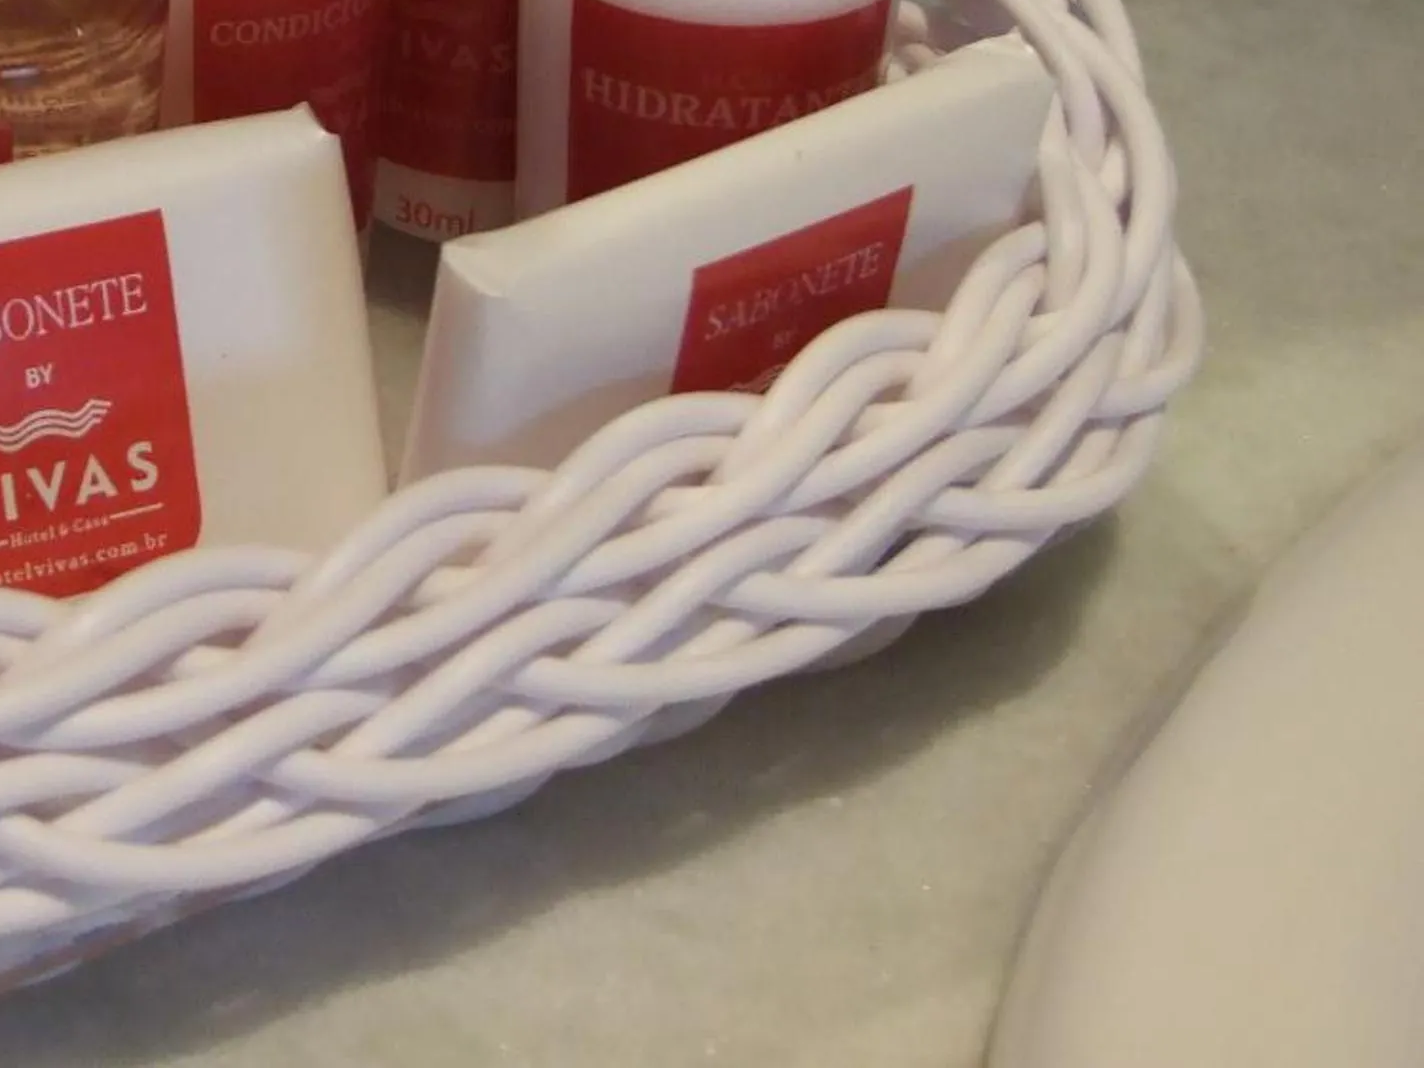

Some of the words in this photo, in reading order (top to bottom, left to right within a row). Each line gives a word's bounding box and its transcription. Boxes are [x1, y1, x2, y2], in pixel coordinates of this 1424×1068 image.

[396, 193, 475, 236] 30ml
[704, 241, 884, 341] SABONETE
[25, 364, 54, 389] BY
[10, 525, 55, 548] Hotel
